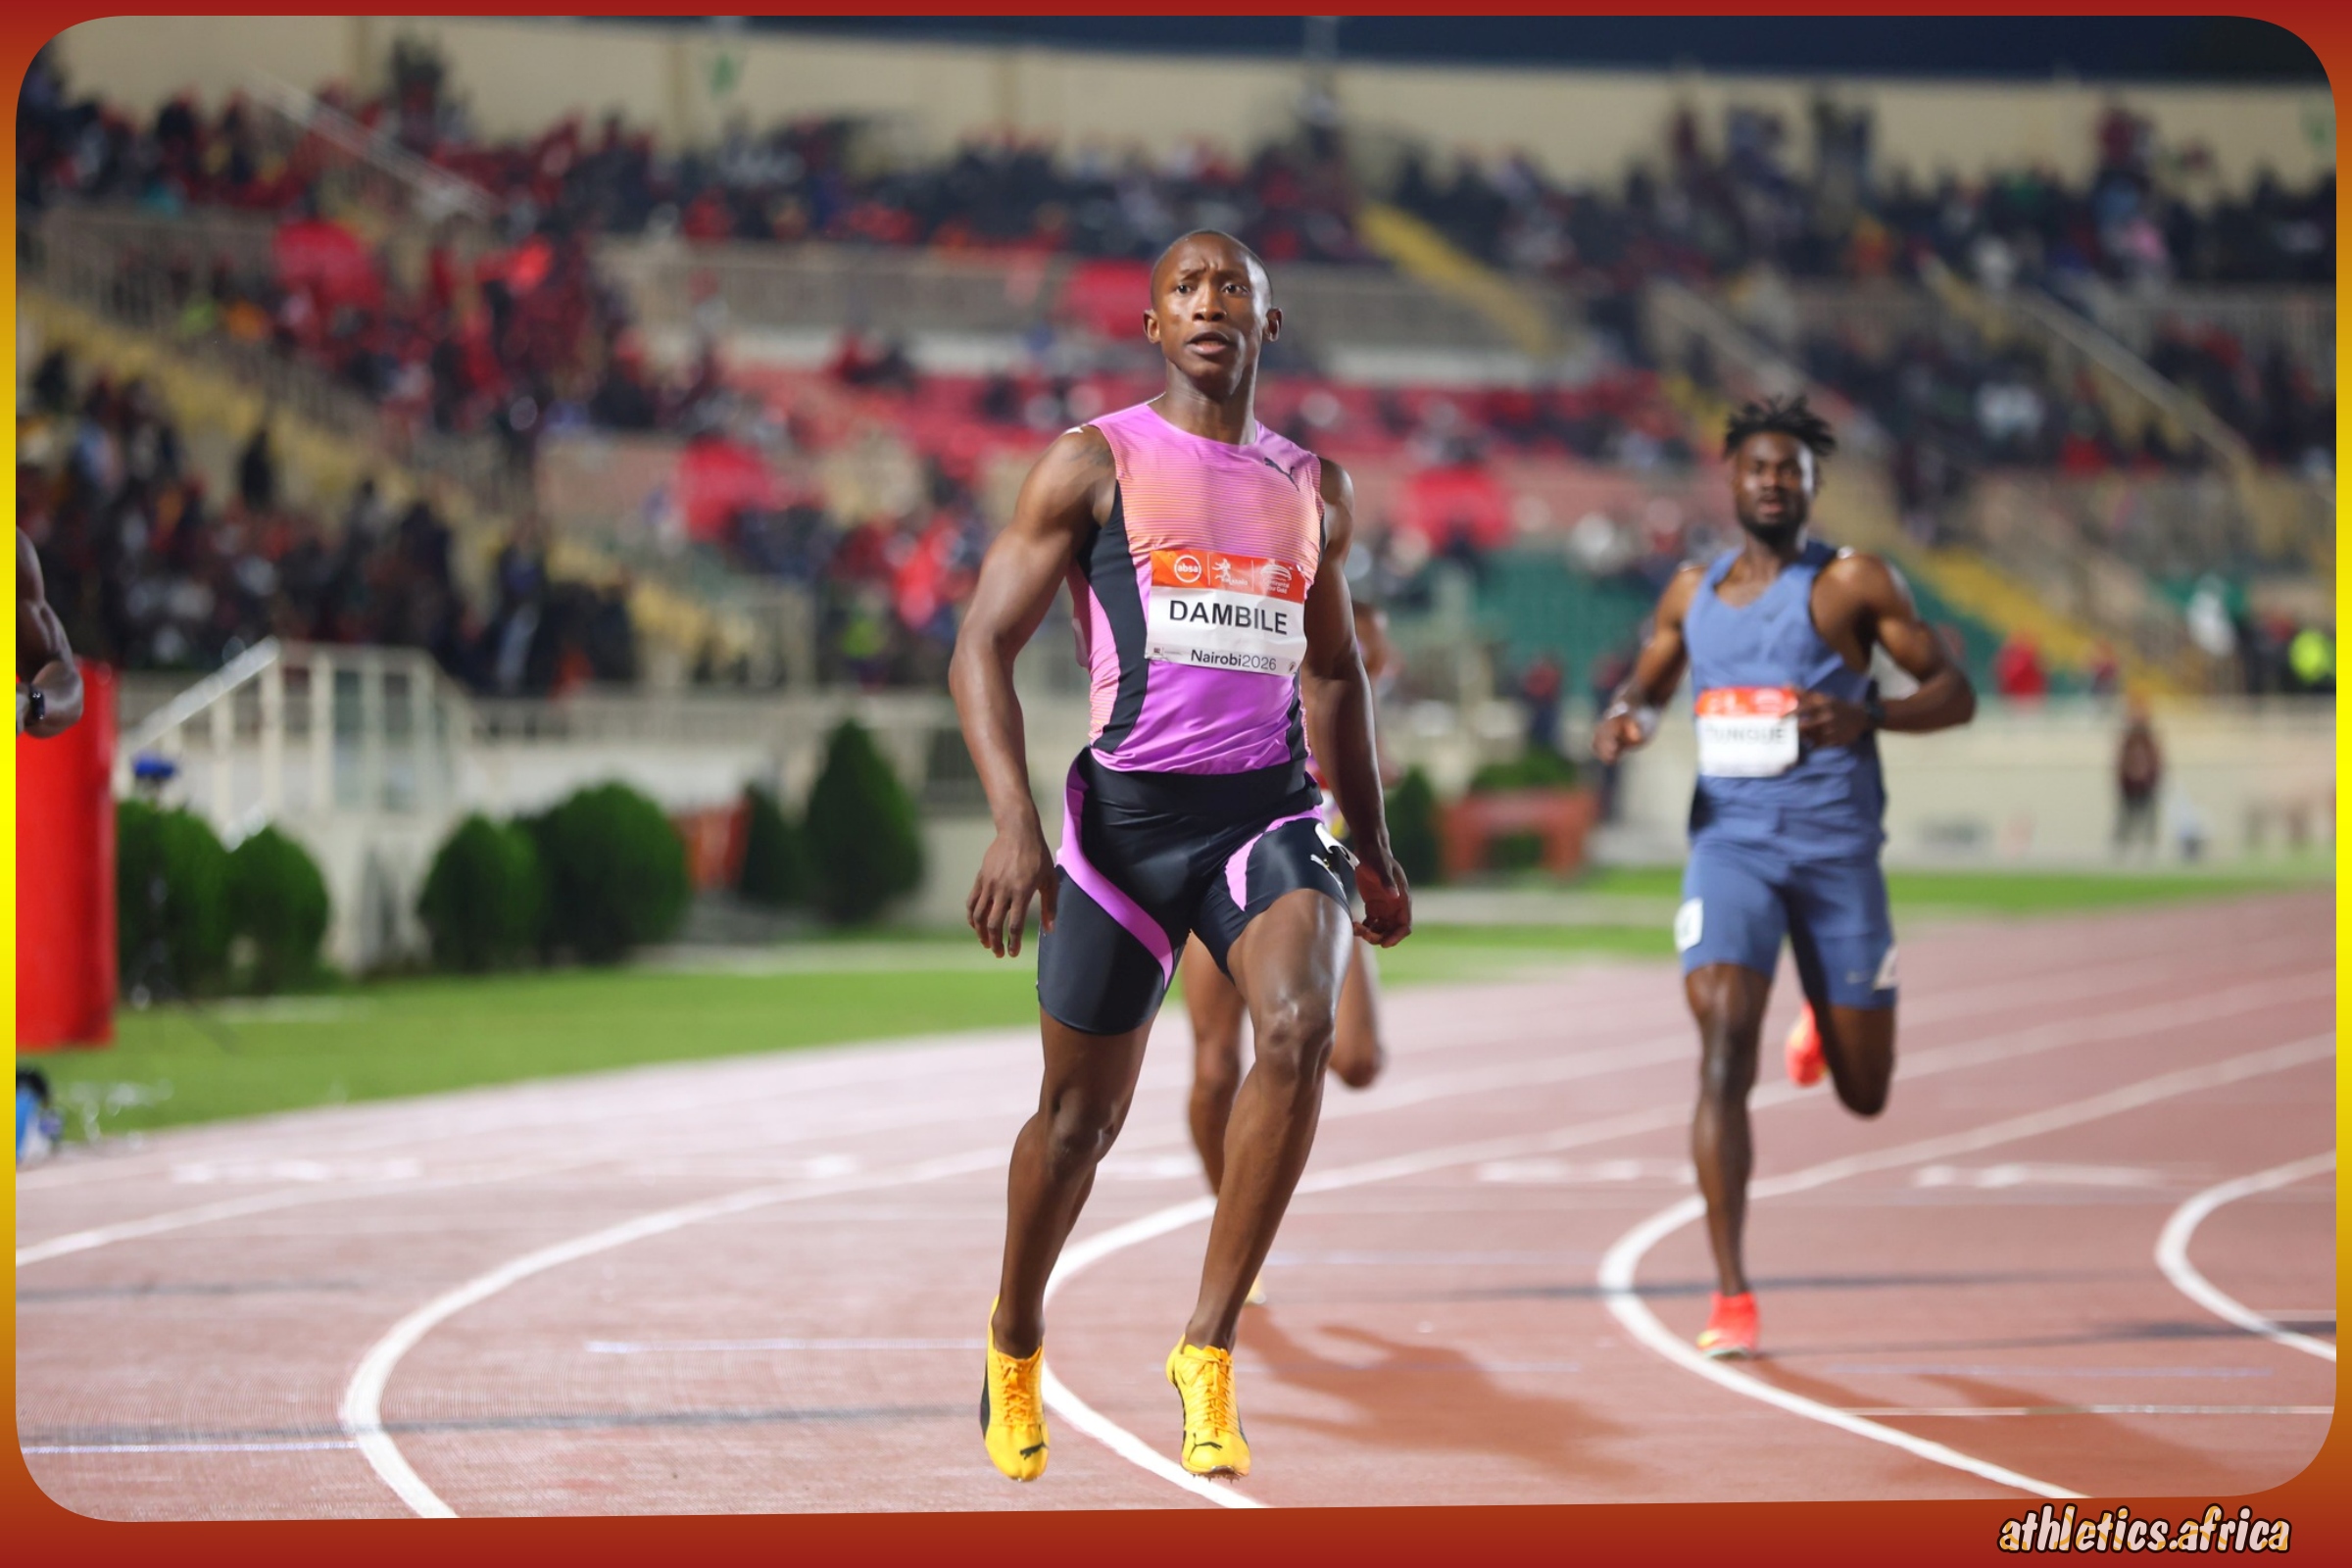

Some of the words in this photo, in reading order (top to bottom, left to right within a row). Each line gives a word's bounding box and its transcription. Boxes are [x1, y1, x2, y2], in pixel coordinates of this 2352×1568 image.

[1177, 563, 1199, 573] absa
[1169, 600, 1288, 635] DAMBILE
[1191, 649, 1277, 671] Nairobi2026
